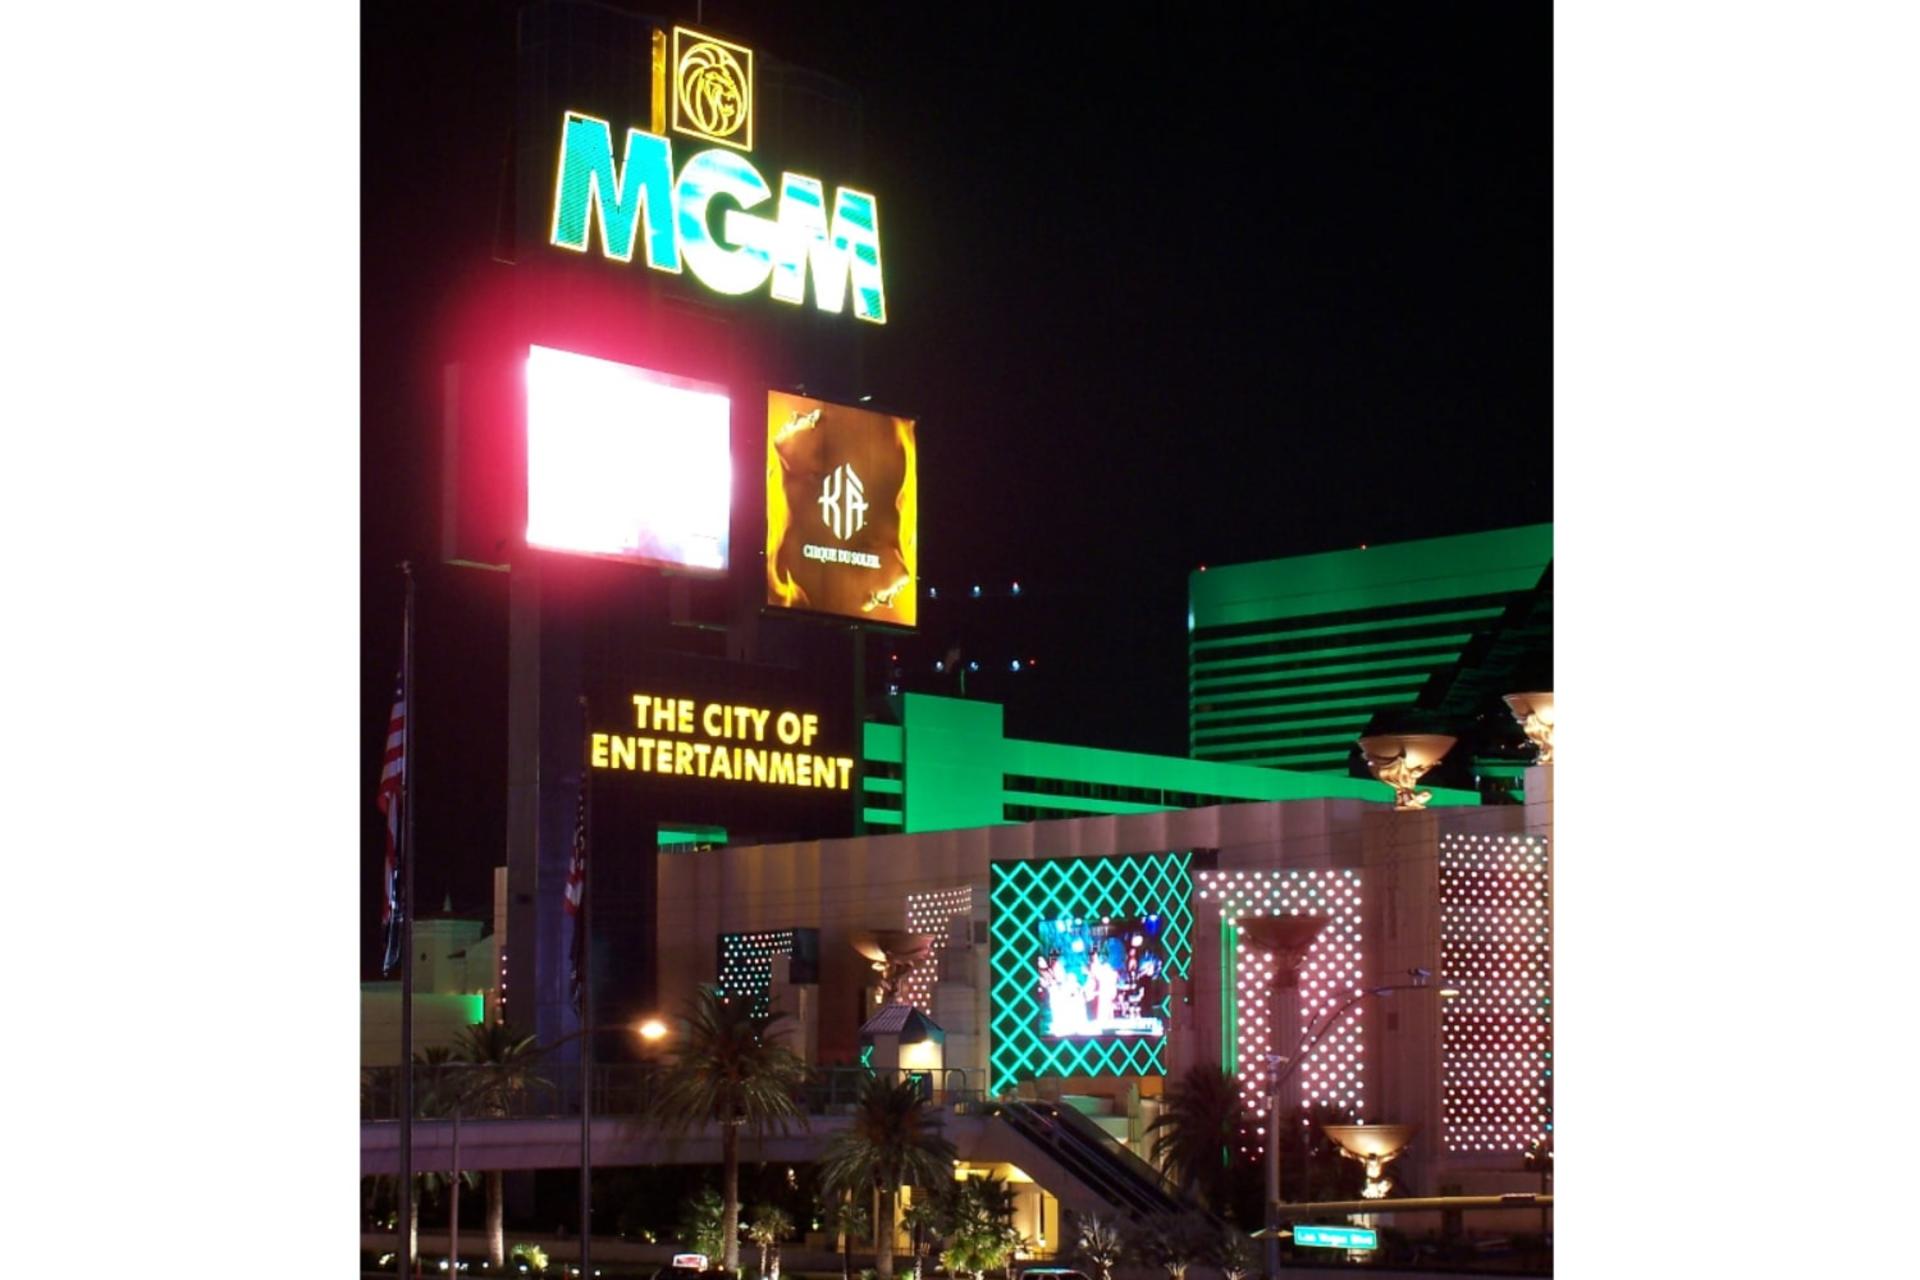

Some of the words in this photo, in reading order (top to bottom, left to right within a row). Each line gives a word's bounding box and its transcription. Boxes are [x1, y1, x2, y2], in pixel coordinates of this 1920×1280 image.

[550, 111, 887, 325] MGM
[803, 544, 837, 562] CIRQUE
[838, 549, 851, 564] DU
[633, 694, 695, 733] THE
[703, 703, 770, 742] CITY
[776, 711, 818, 746] OF
[591, 733, 853, 789] ENTERTAINMENT
